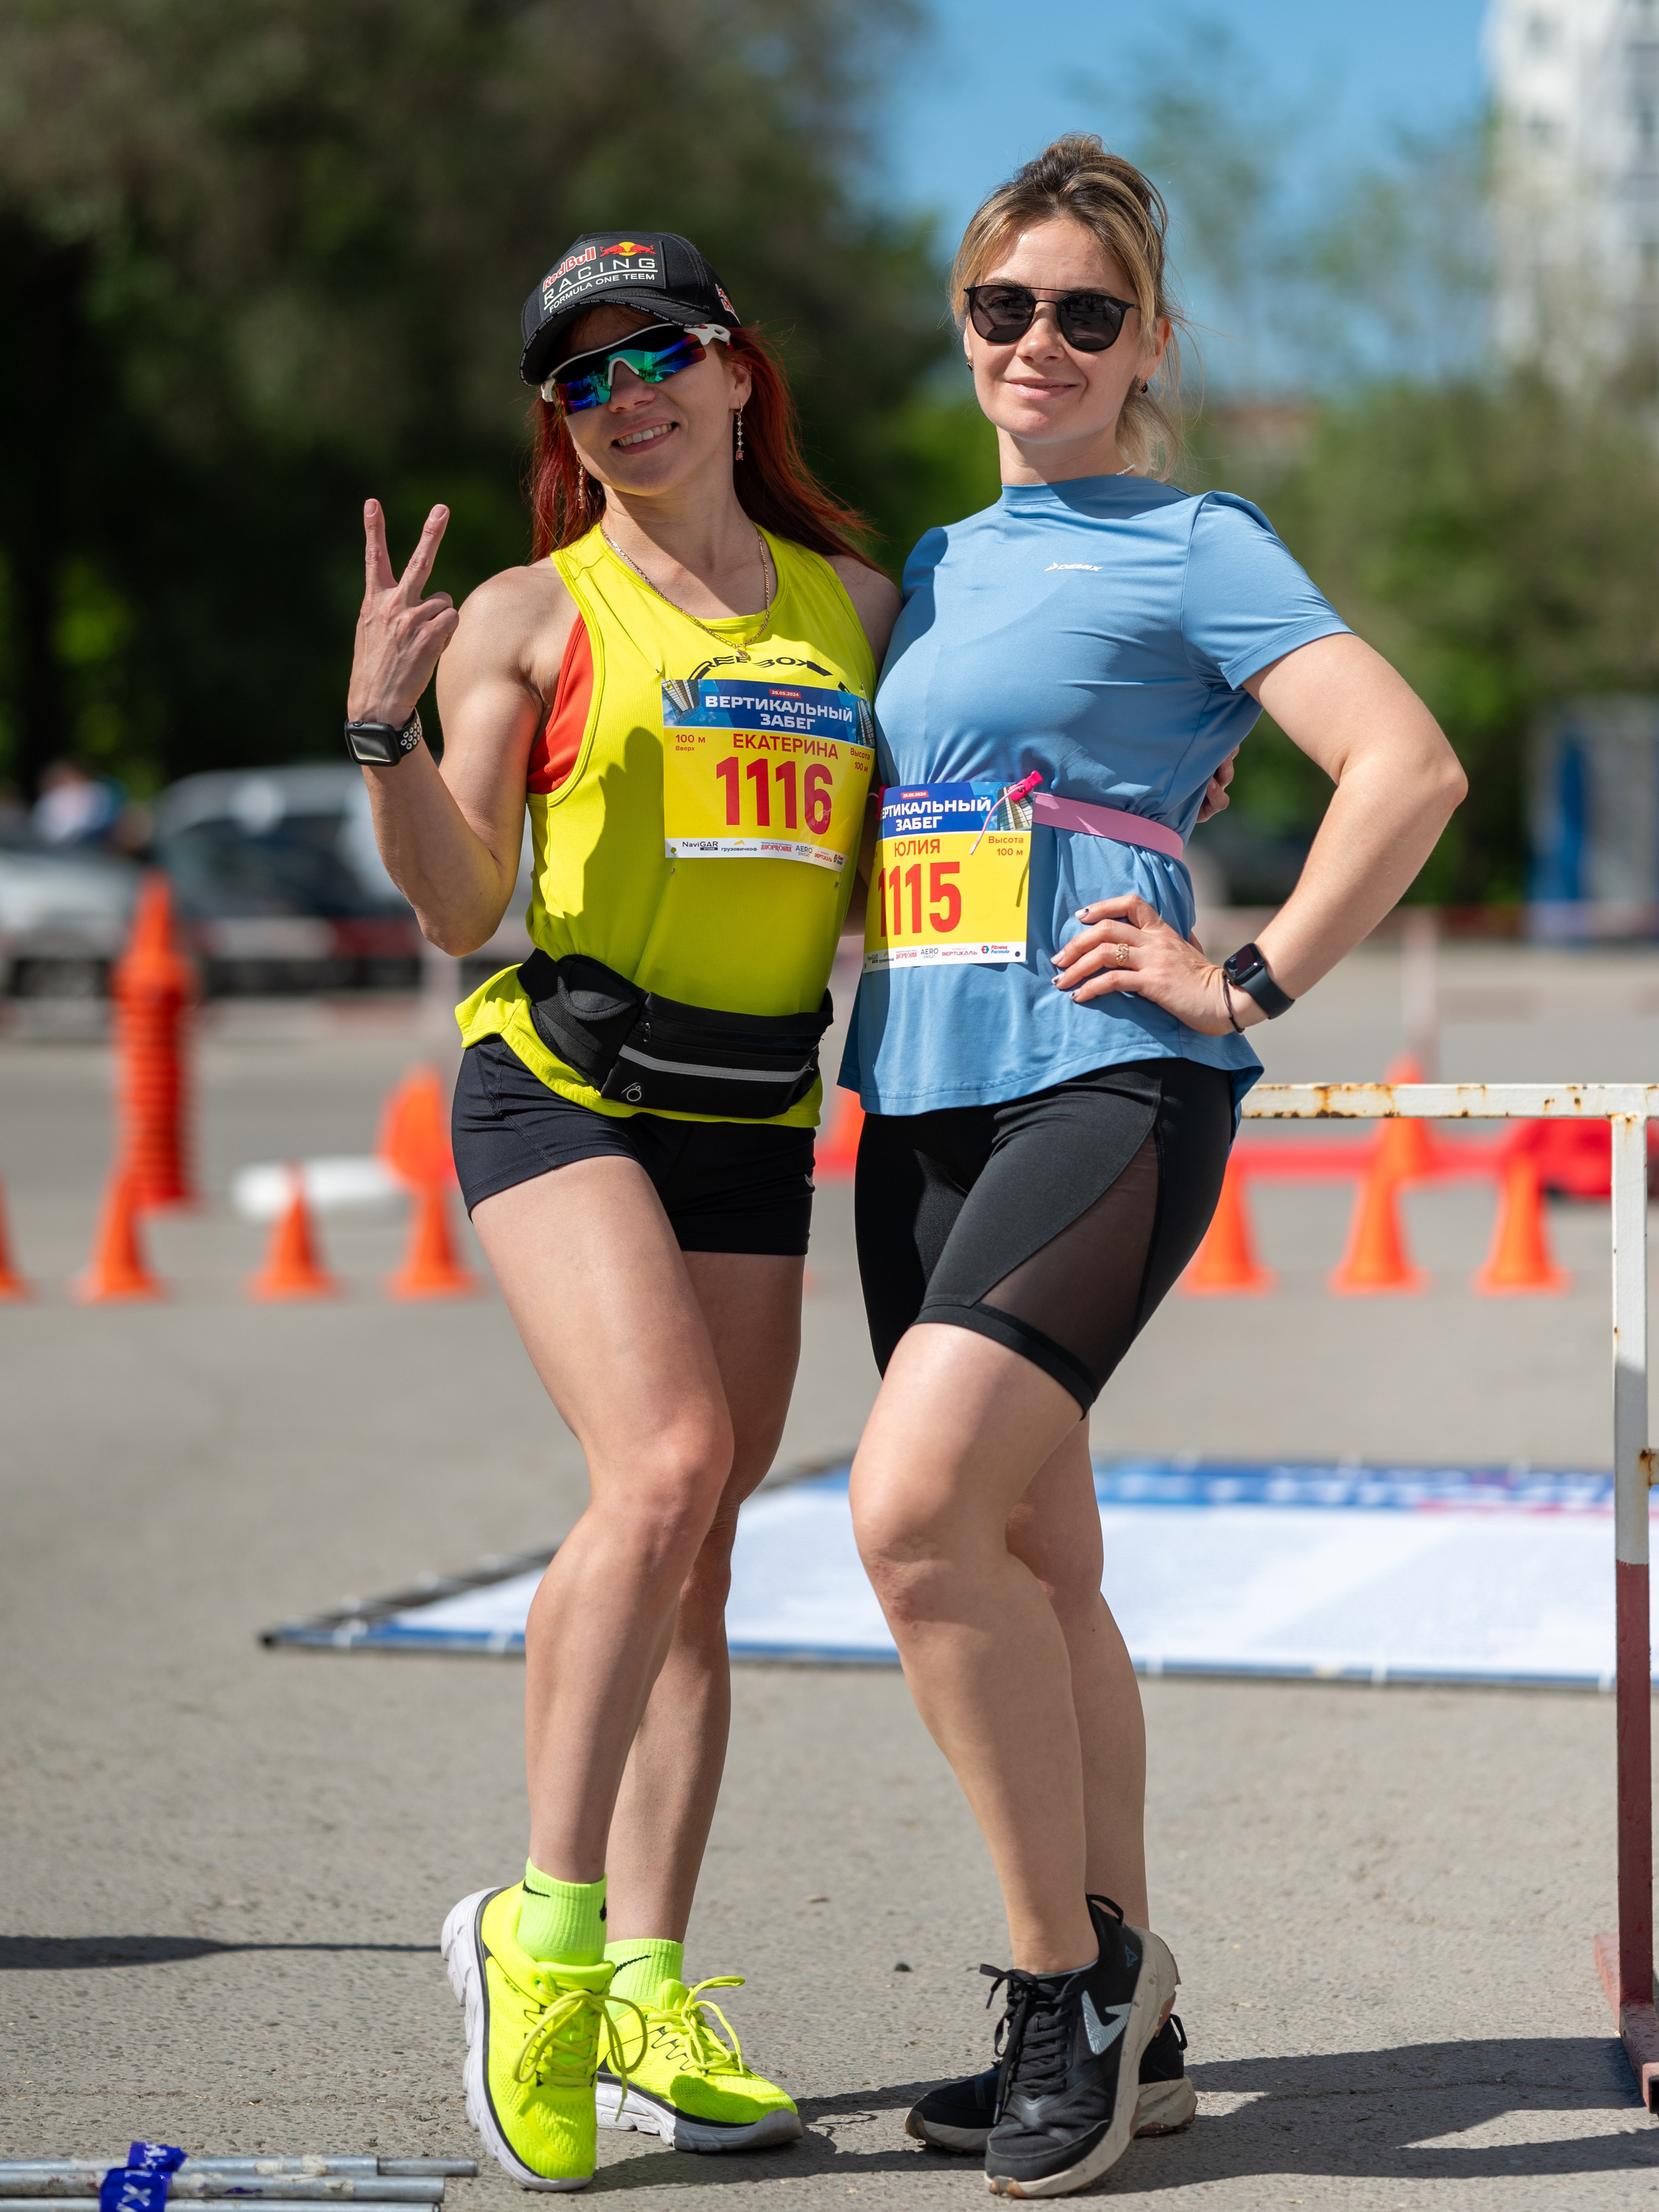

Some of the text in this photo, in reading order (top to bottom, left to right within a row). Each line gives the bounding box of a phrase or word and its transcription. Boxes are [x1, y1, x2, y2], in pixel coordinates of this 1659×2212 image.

[544, 258, 656, 305] RACING
[549, 282, 593, 314] FORMULA
[596, 275, 620, 286] ONE
[705, 696, 853, 723] ВЕРТИКАЛЬНЫЙ
[760, 714, 815, 730] ЗАБЕГ
[675, 734, 695, 743] 100
[733, 733, 839, 760] ЕКАТЕРИНА
[850, 747, 870, 760] Высота
[854, 762, 863, 771] 100
[716, 756, 833, 835] 1116
[881, 797, 992, 820] ЕРТИКАЛЬНЫЙ
[896, 816, 943, 832] ЗАБЕГ
[795, 845, 813, 854] AERO
[894, 839, 940, 857] ЮЛИЯ
[877, 861, 962, 937] 1115
